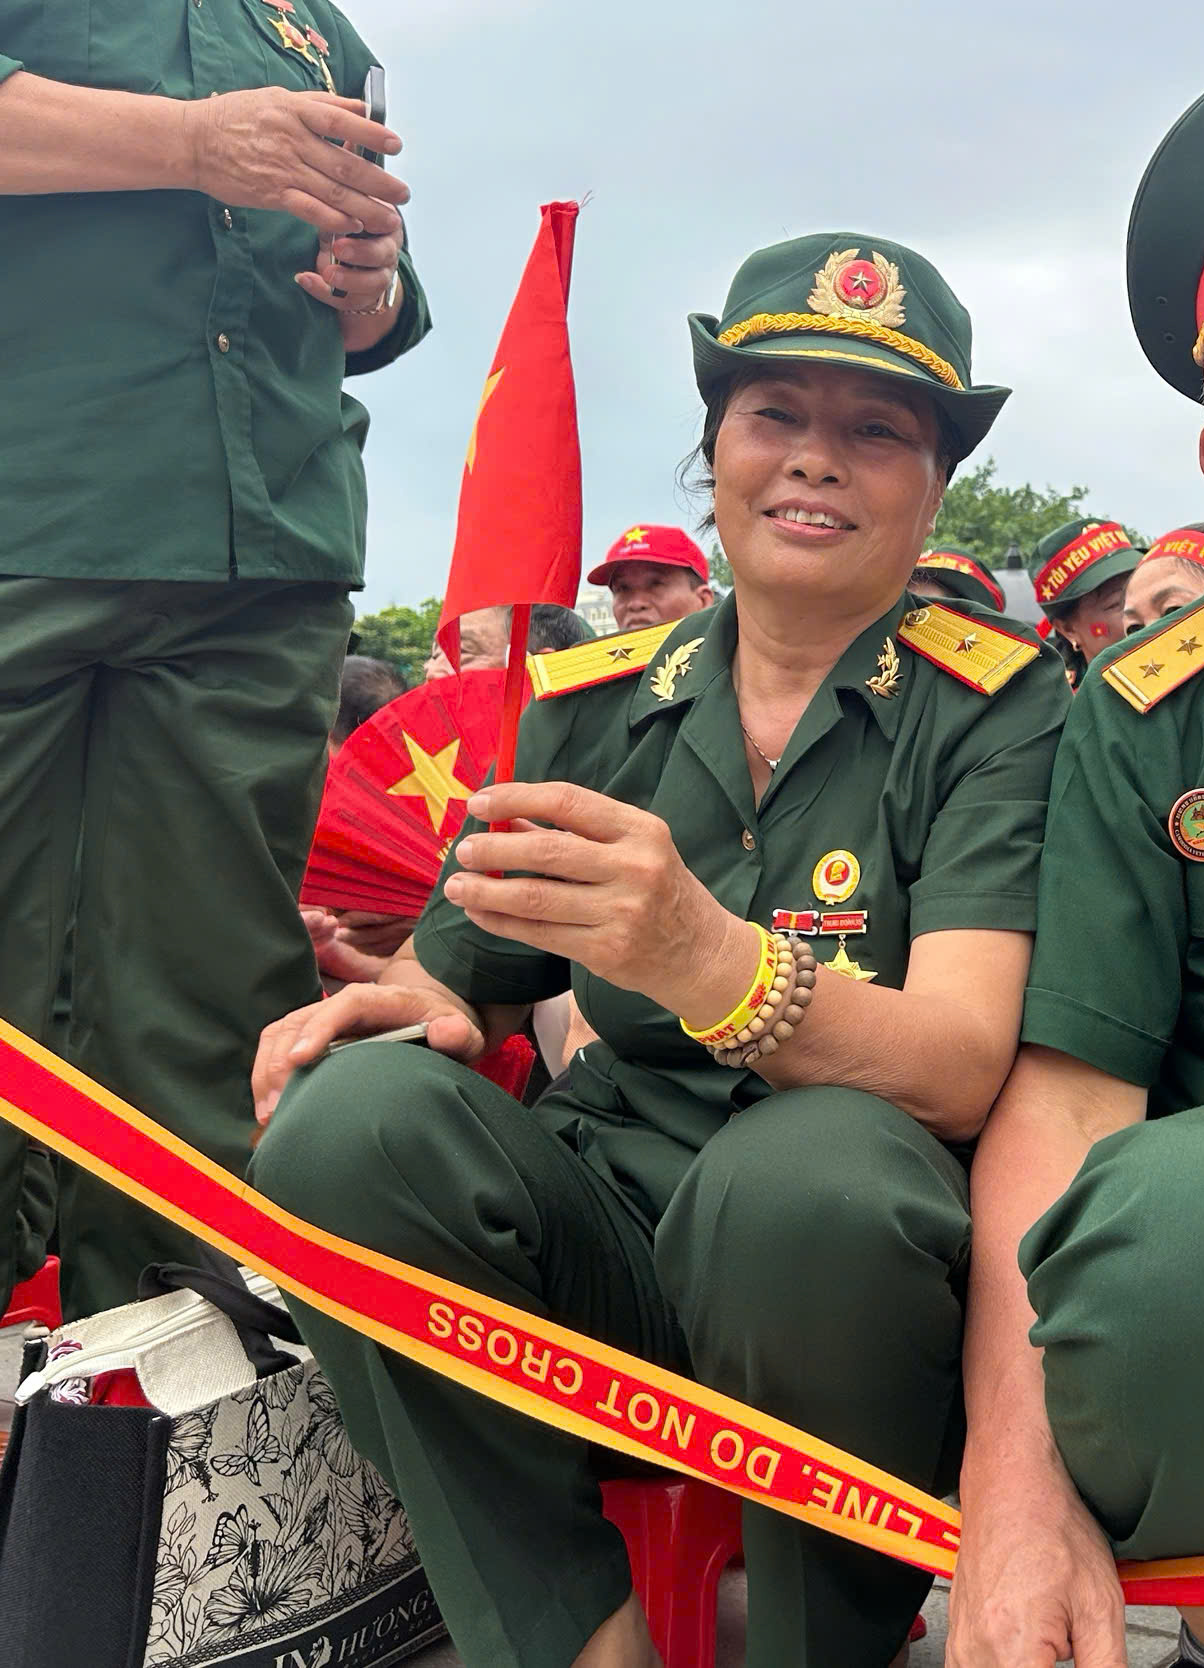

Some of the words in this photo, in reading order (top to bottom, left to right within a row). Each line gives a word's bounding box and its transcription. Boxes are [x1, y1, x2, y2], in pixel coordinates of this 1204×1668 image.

[1048, 566, 1069, 589] TÔI
[1063, 546, 1091, 573] YÊU
[427, 1302, 583, 1394] CROSS
[596, 1380, 696, 1449] NOT
[710, 1430, 781, 1488] DO
